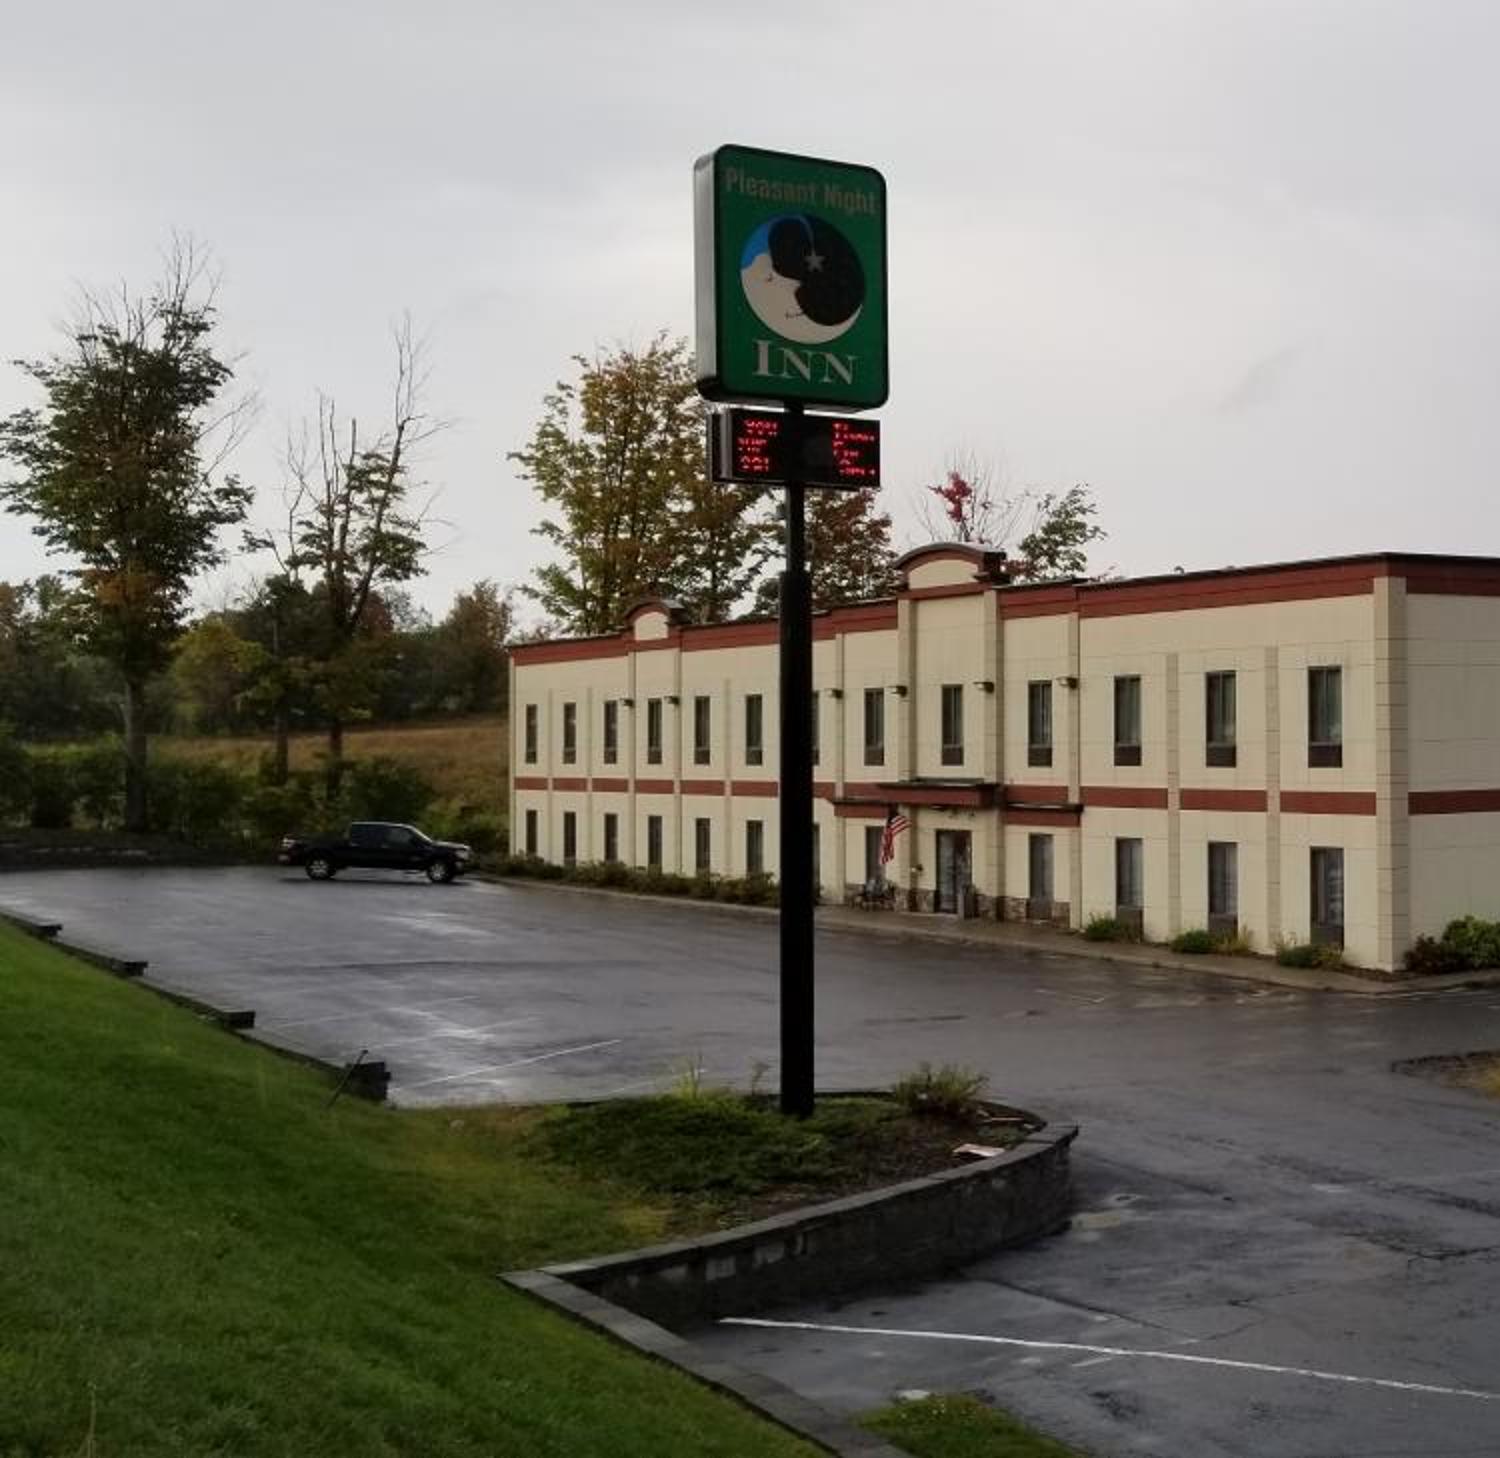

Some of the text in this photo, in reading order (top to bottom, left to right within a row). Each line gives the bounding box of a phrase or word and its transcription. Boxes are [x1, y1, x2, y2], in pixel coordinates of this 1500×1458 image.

[725, 168, 877, 216] Pleasant Night
[752, 339, 858, 385] INN
